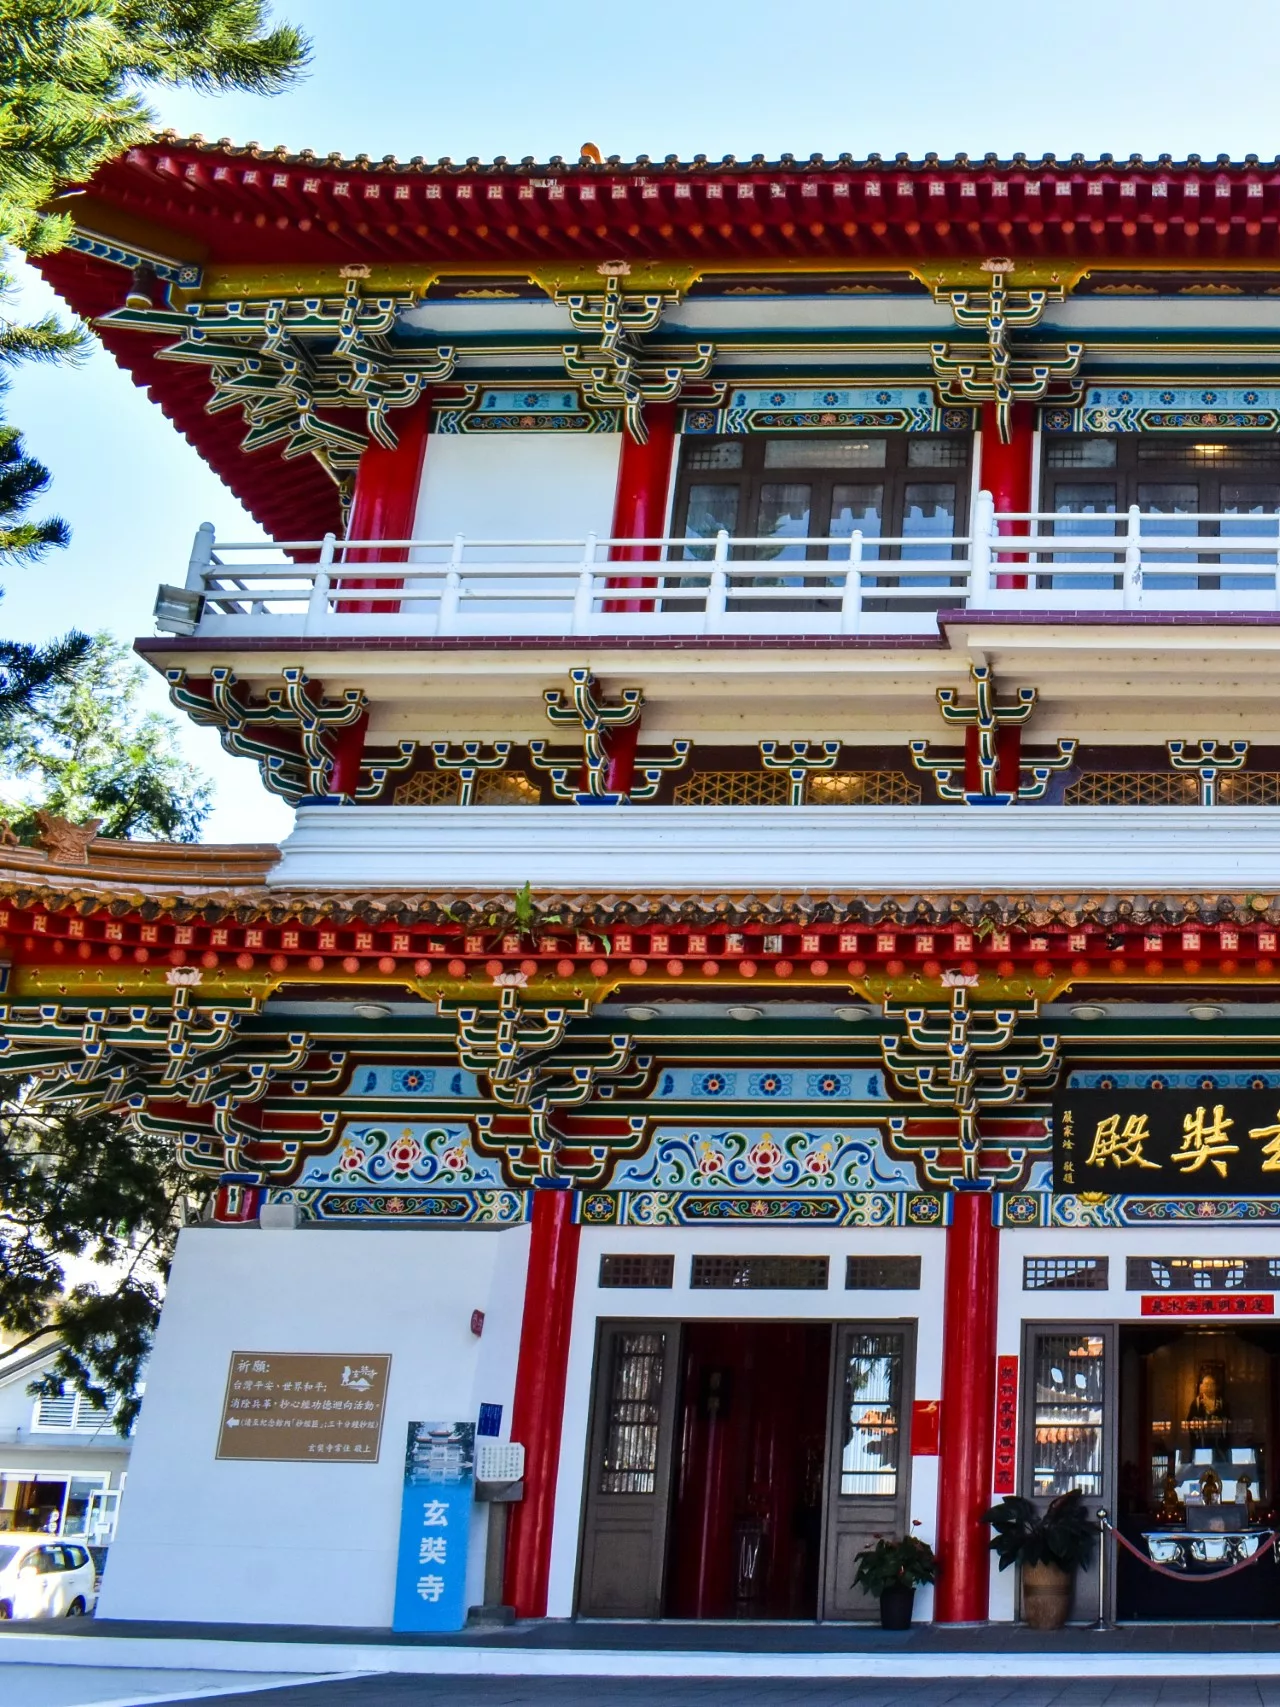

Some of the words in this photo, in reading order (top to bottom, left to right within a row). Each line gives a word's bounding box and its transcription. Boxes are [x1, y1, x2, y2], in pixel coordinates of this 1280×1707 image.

[1062, 1109, 1075, 1150] 嚴家淦
[416, 1499, 450, 1602] 玄奘寺
